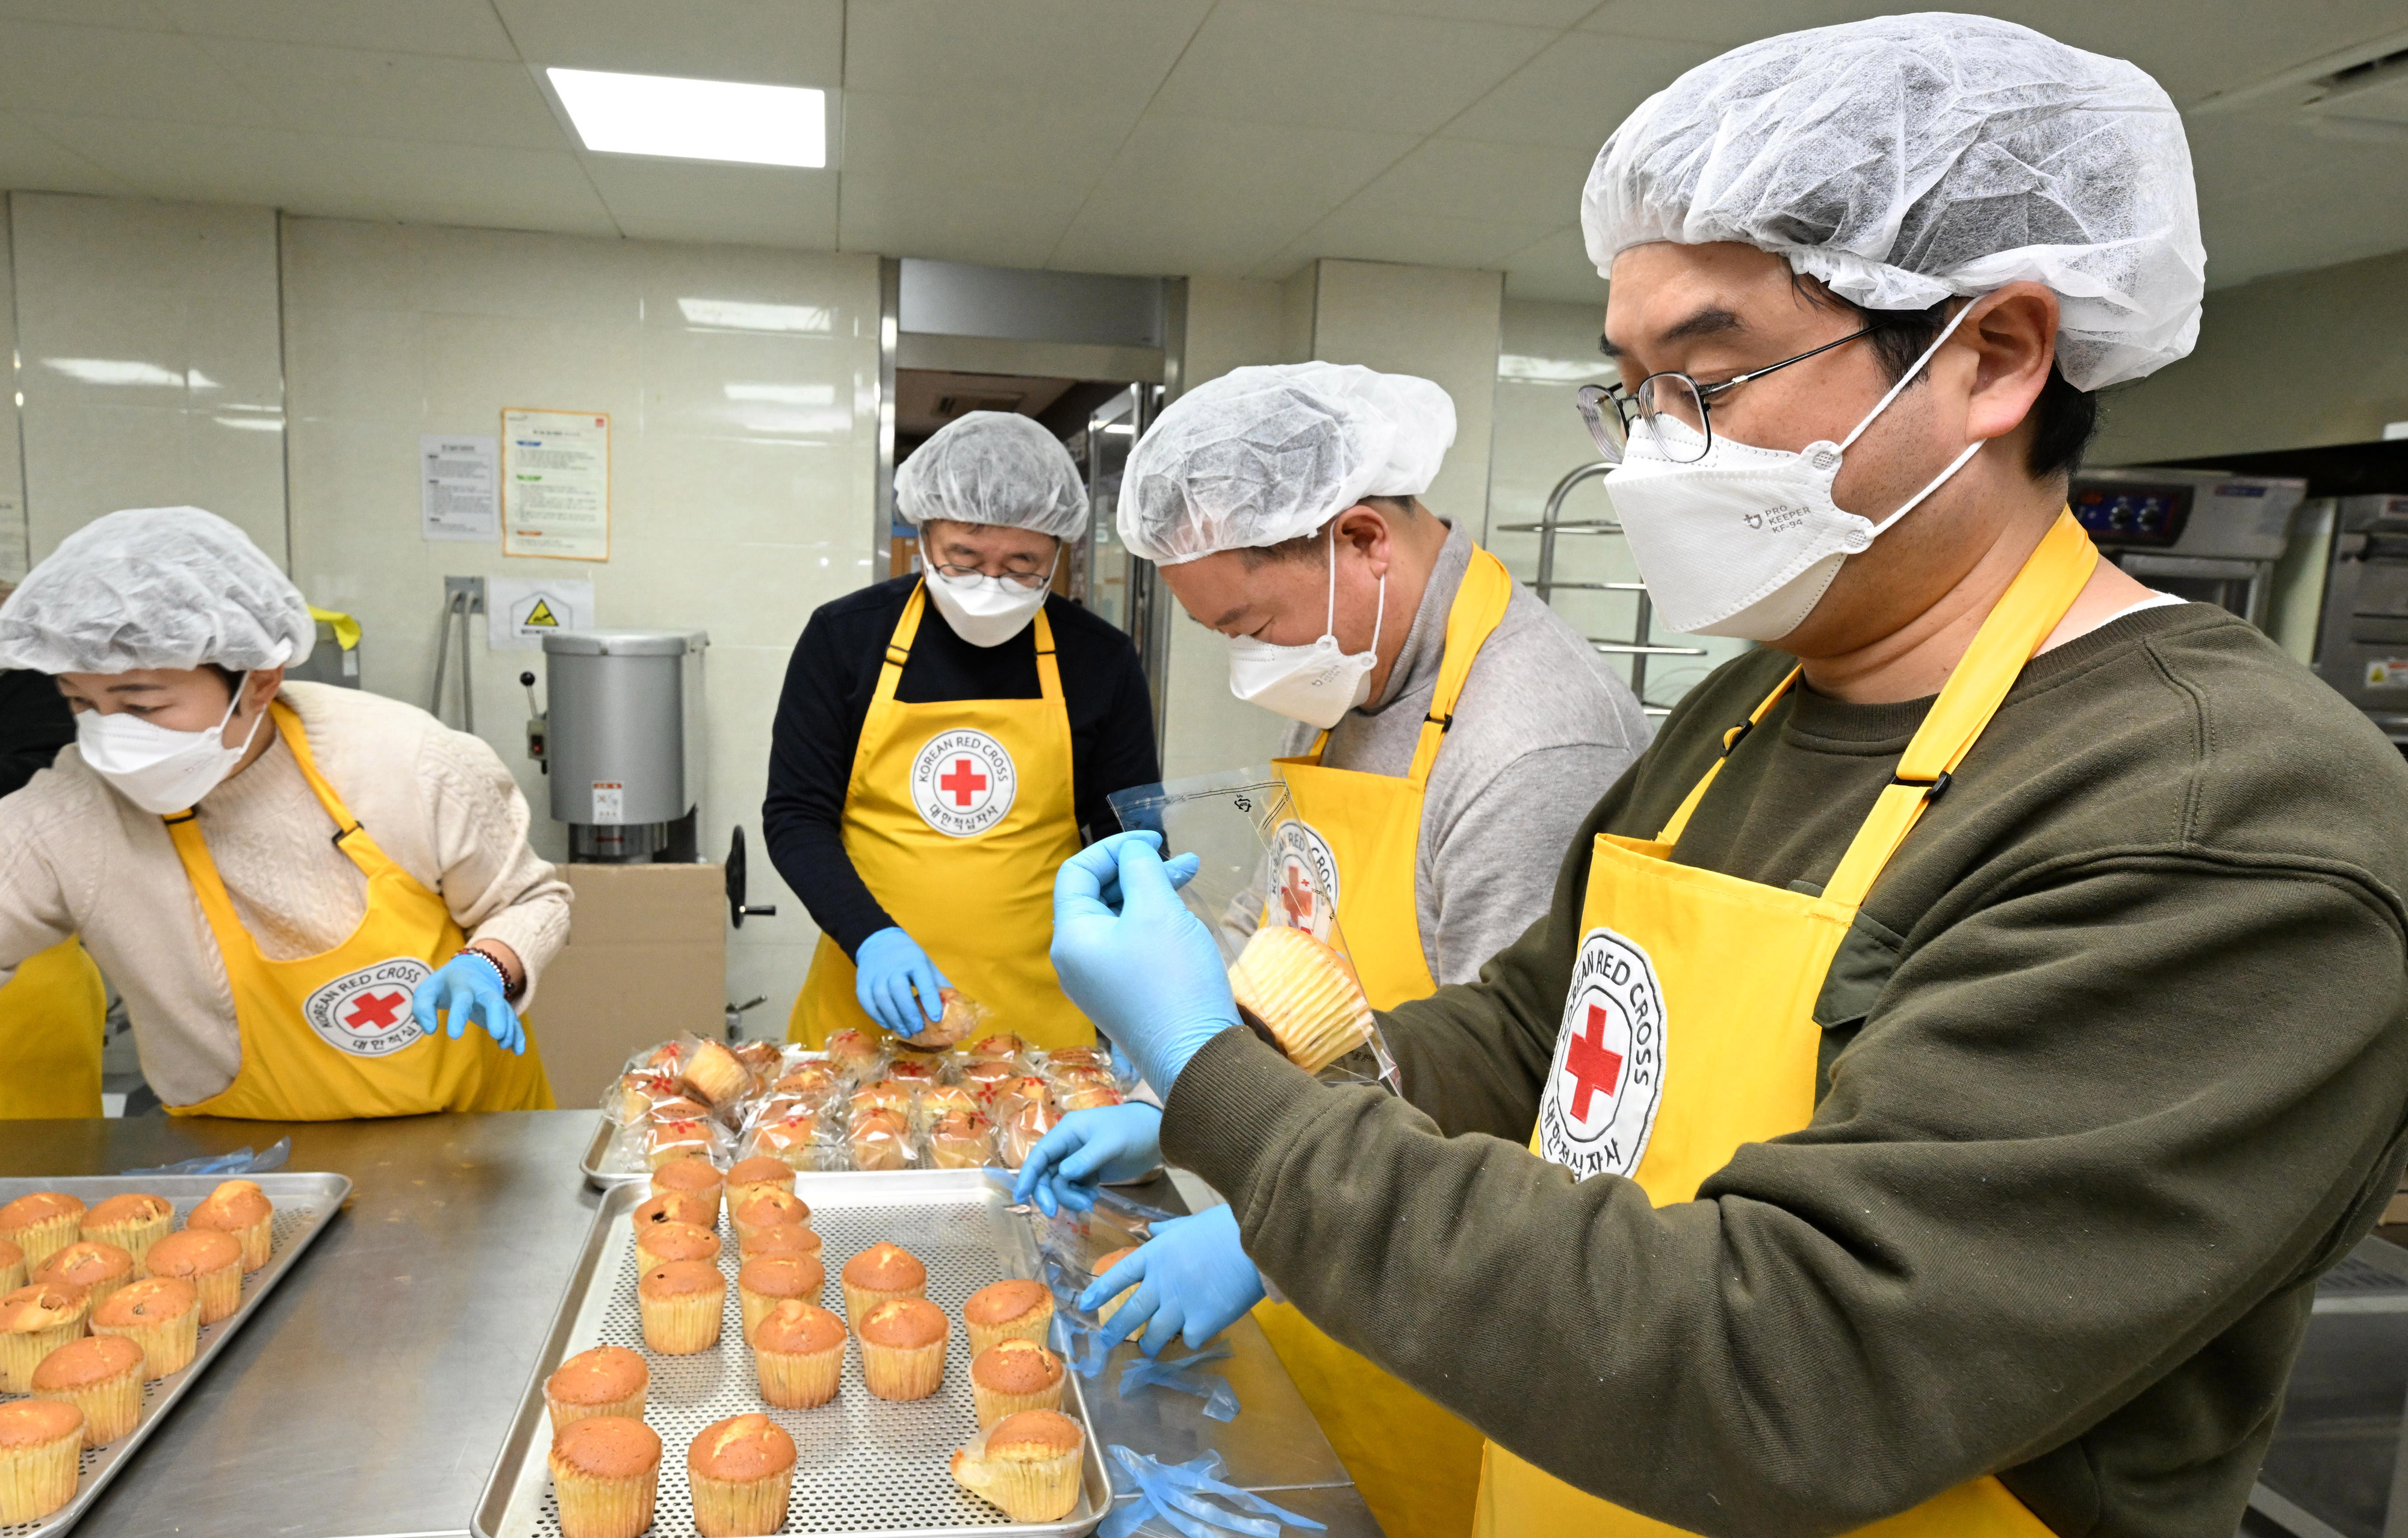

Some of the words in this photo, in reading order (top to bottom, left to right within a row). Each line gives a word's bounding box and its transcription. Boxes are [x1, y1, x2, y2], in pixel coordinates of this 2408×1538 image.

[1765, 505, 1787, 517] PRO
[1769, 507, 1811, 526] KEEPER
[1772, 519, 1803, 534] KF-94
[919, 739, 953, 783] KOREAN
[956, 736, 981, 749] RED
[982, 745, 1008, 782] CROSS
[929, 804, 999, 831] 대한적십자사
[1288, 832, 1305, 852] RED
[338, 974, 371, 992] RED
[377, 966, 421, 983] CROSS
[1596, 949, 1631, 986] RED
[1630, 982, 1652, 1087] CROSS
[1545, 1096, 1622, 1182] 대한적십자사
